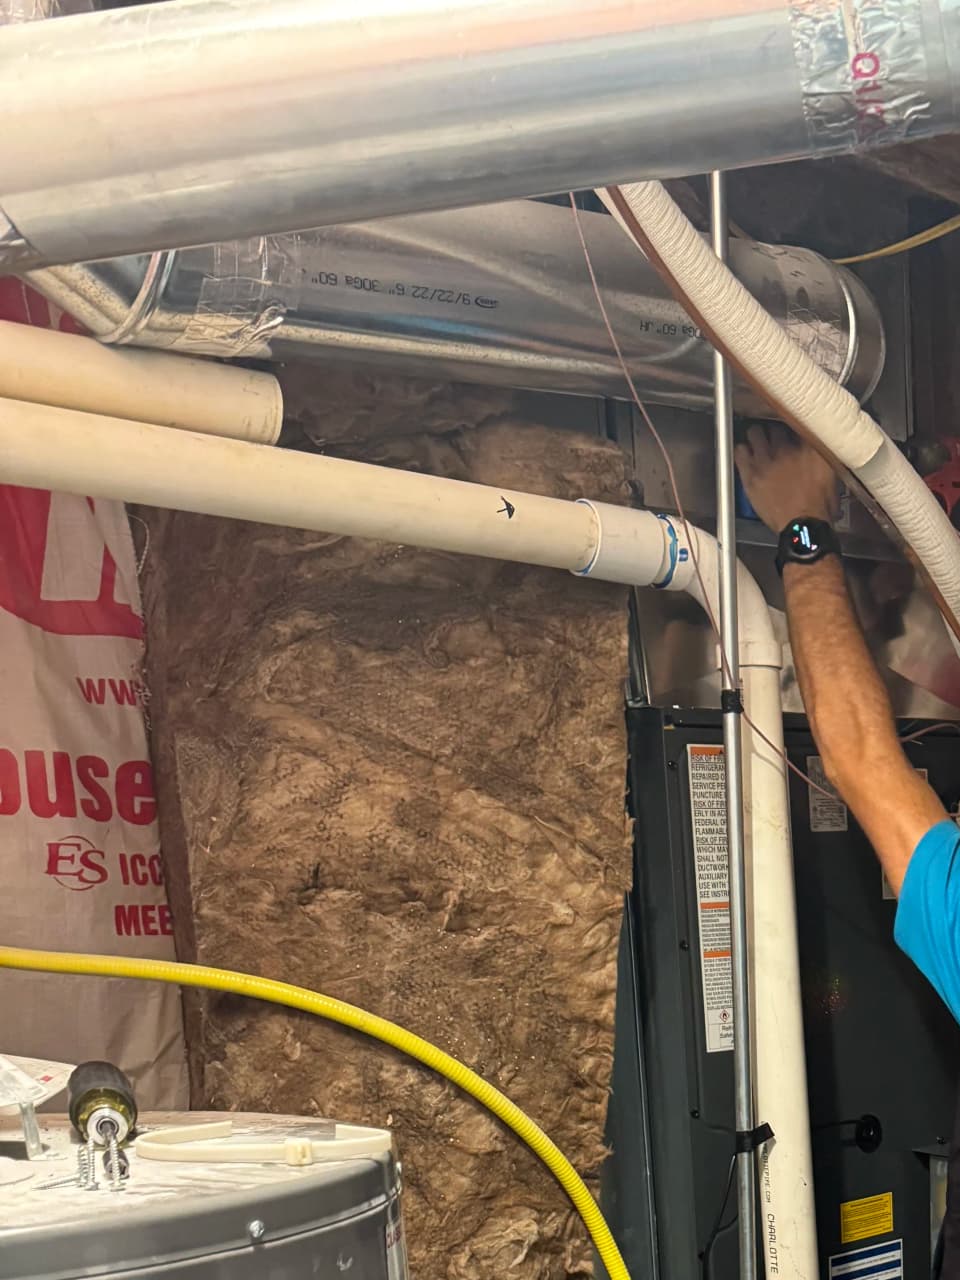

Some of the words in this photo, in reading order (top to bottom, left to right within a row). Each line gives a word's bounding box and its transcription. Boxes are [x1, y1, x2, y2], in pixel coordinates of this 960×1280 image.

[692, 782, 716, 790] SERVICE
[692, 791, 722, 799] PUNCTURE
[695, 818, 719, 827] FEDERAL
[696, 837, 709, 845] RISK
[696, 845, 716, 853] WHICH
[697, 854, 714, 862] SHALL
[766, 1212, 779, 1275] CHARLOTTE
